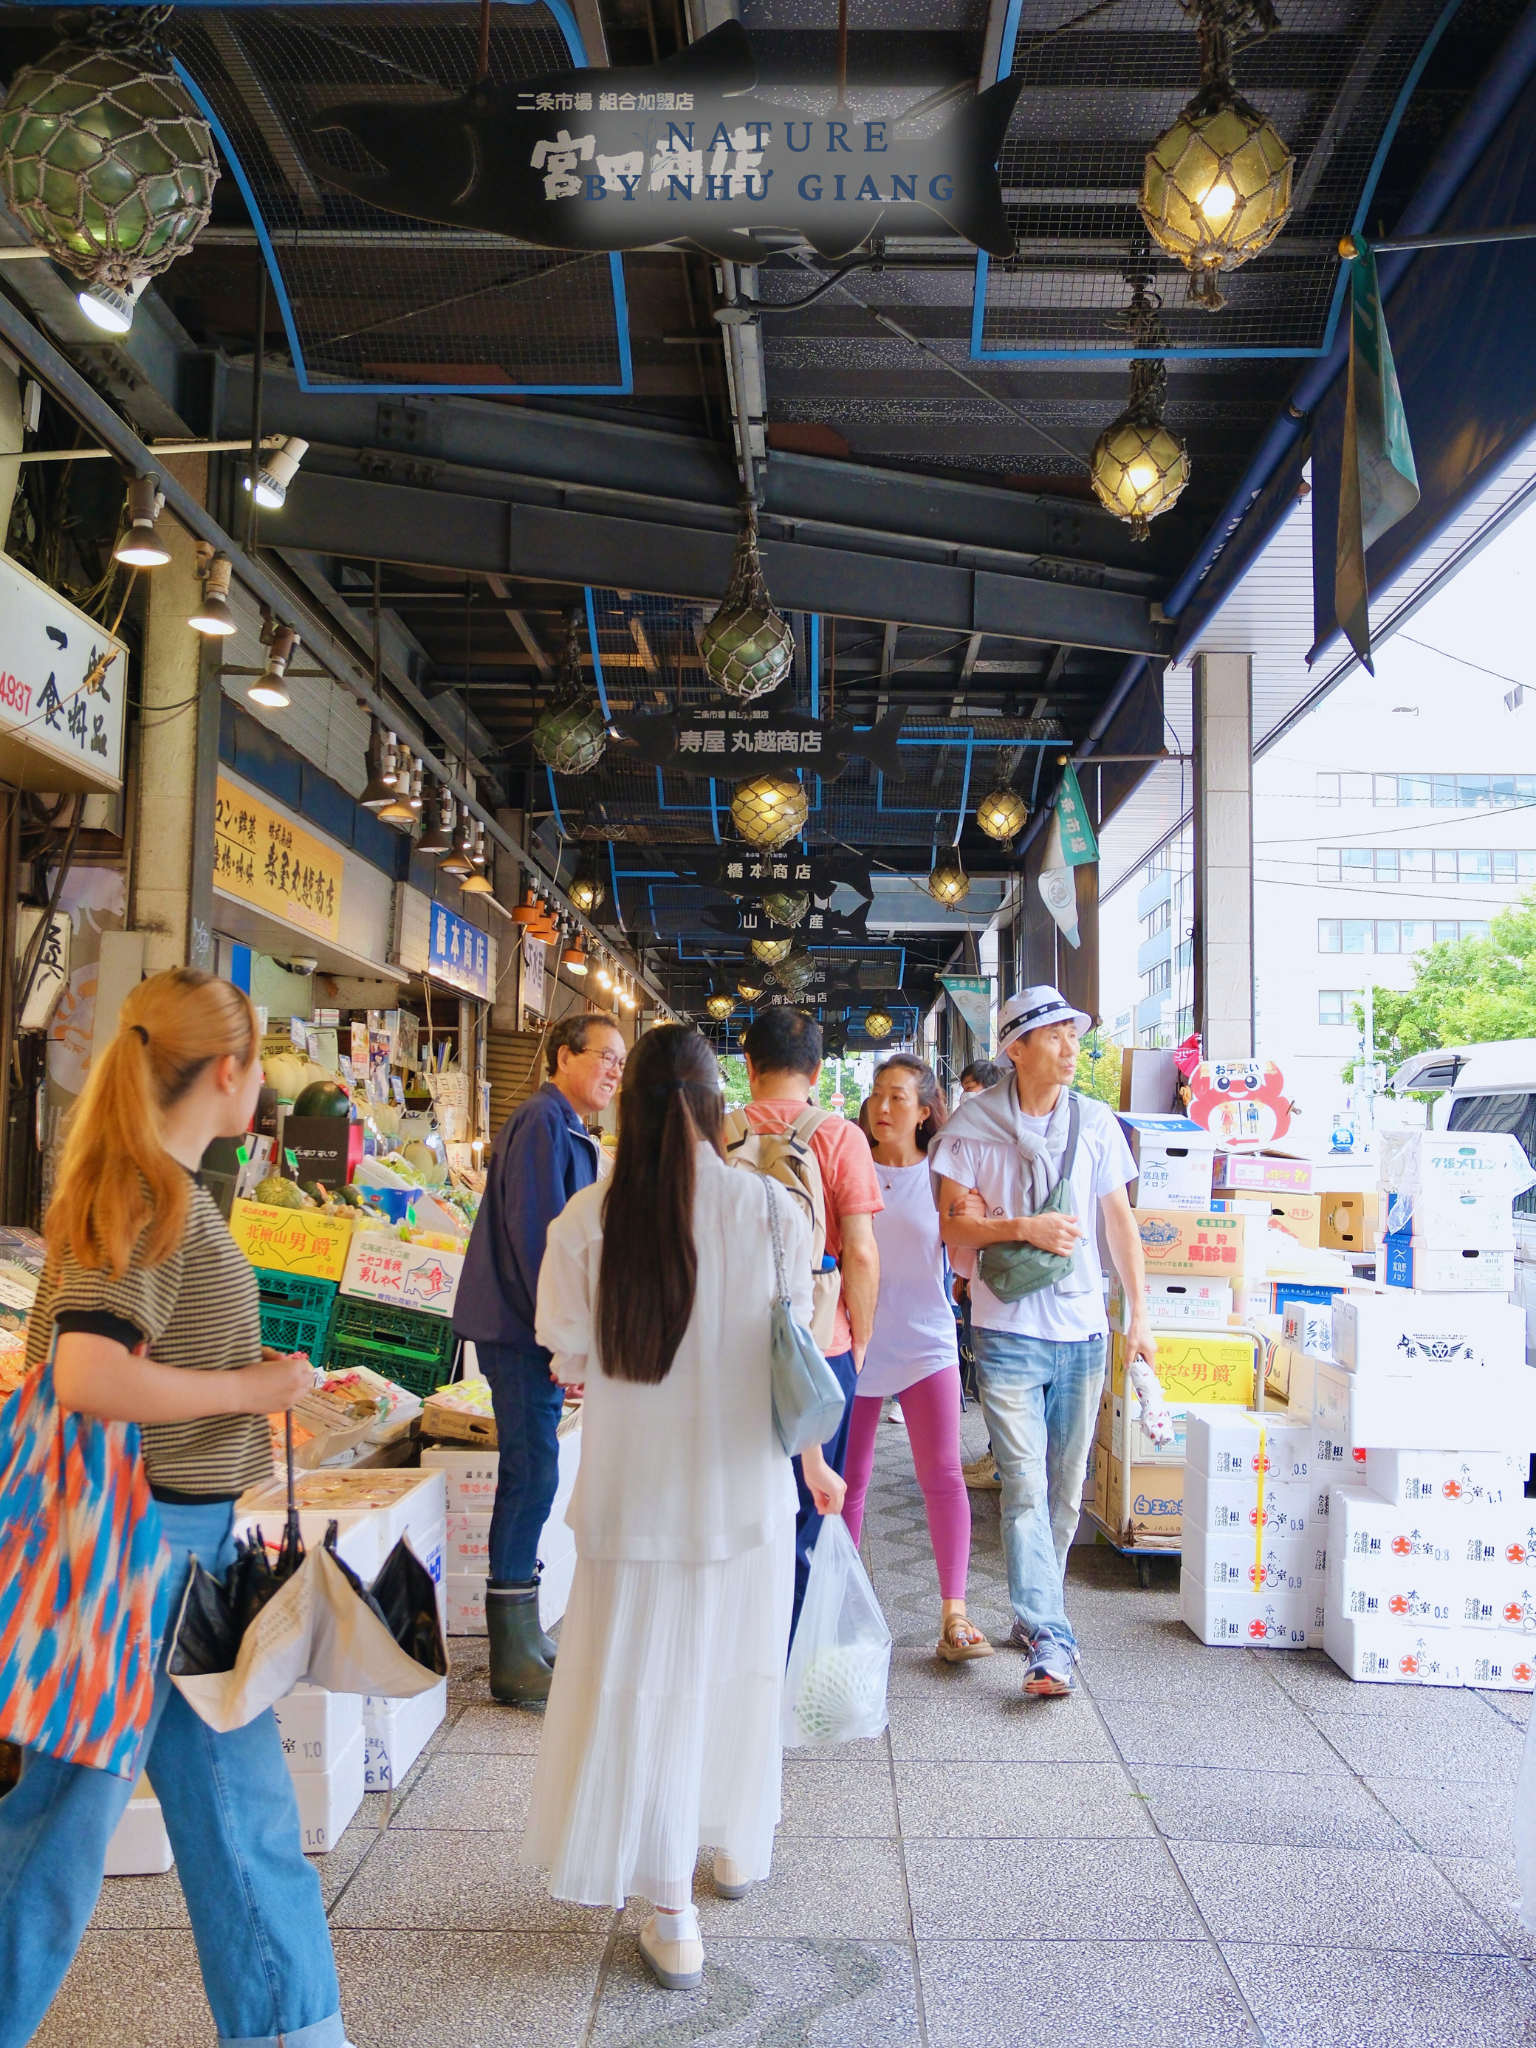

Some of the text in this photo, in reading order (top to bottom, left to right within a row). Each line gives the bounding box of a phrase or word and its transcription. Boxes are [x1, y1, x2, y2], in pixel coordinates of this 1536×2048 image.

[516, 92, 694, 111] 二条市場 組合加盟店
[36, 671, 108, 757] 食料品
[693, 710, 769, 719] 二条市場 組盟店
[679, 729, 822, 753] 寿屋 丸越商店
[727, 862, 811, 880] 橋本商店
[743, 913, 824, 929] 山産
[436, 909, 484, 977] 橋本商店
[949, 980, 986, 989] 二条市場
[1215, 1063, 1260, 1076] お手洗い
[1143, 1171, 1169, 1180] 富良野
[1142, 1180, 1168, 1188] メロン
[1197, 1232, 1228, 1245] 真狩
[360, 1242, 411, 1260] 北海道ニセコ産
[1188, 1245, 1238, 1263] 馬鈴薯
[358, 1267, 401, 1290] 男しゃく
[1199, 1288, 1210, 1298] 選
[1304, 1320, 1318, 1348] タラバ
[1333, 1446, 1343, 1457] 根
[1232, 1457, 1242, 1468] 根
[1421, 1483, 1432, 1494] 根
[1229, 1511, 1239, 1522] 根
[1290, 1519, 1304, 1530] 0.9
[1370, 1538, 1381, 1549] 根
[1484, 1546, 1495, 1557] 根
[1229, 1567, 1239, 1578] 根
[1288, 1577, 1302, 1588] 0.9
[1367, 1597, 1378, 1609] 根
[1481, 1605, 1493, 1616] 根
[1229, 1623, 1239, 1634] 根
[1291, 1630, 1305, 1642] 0.9
[1378, 1658, 1389, 1669] 根
[1491, 1665, 1502, 1677] 根
[282, 1738, 296, 1753] 室
[305, 1828, 325, 1845] 1.0
